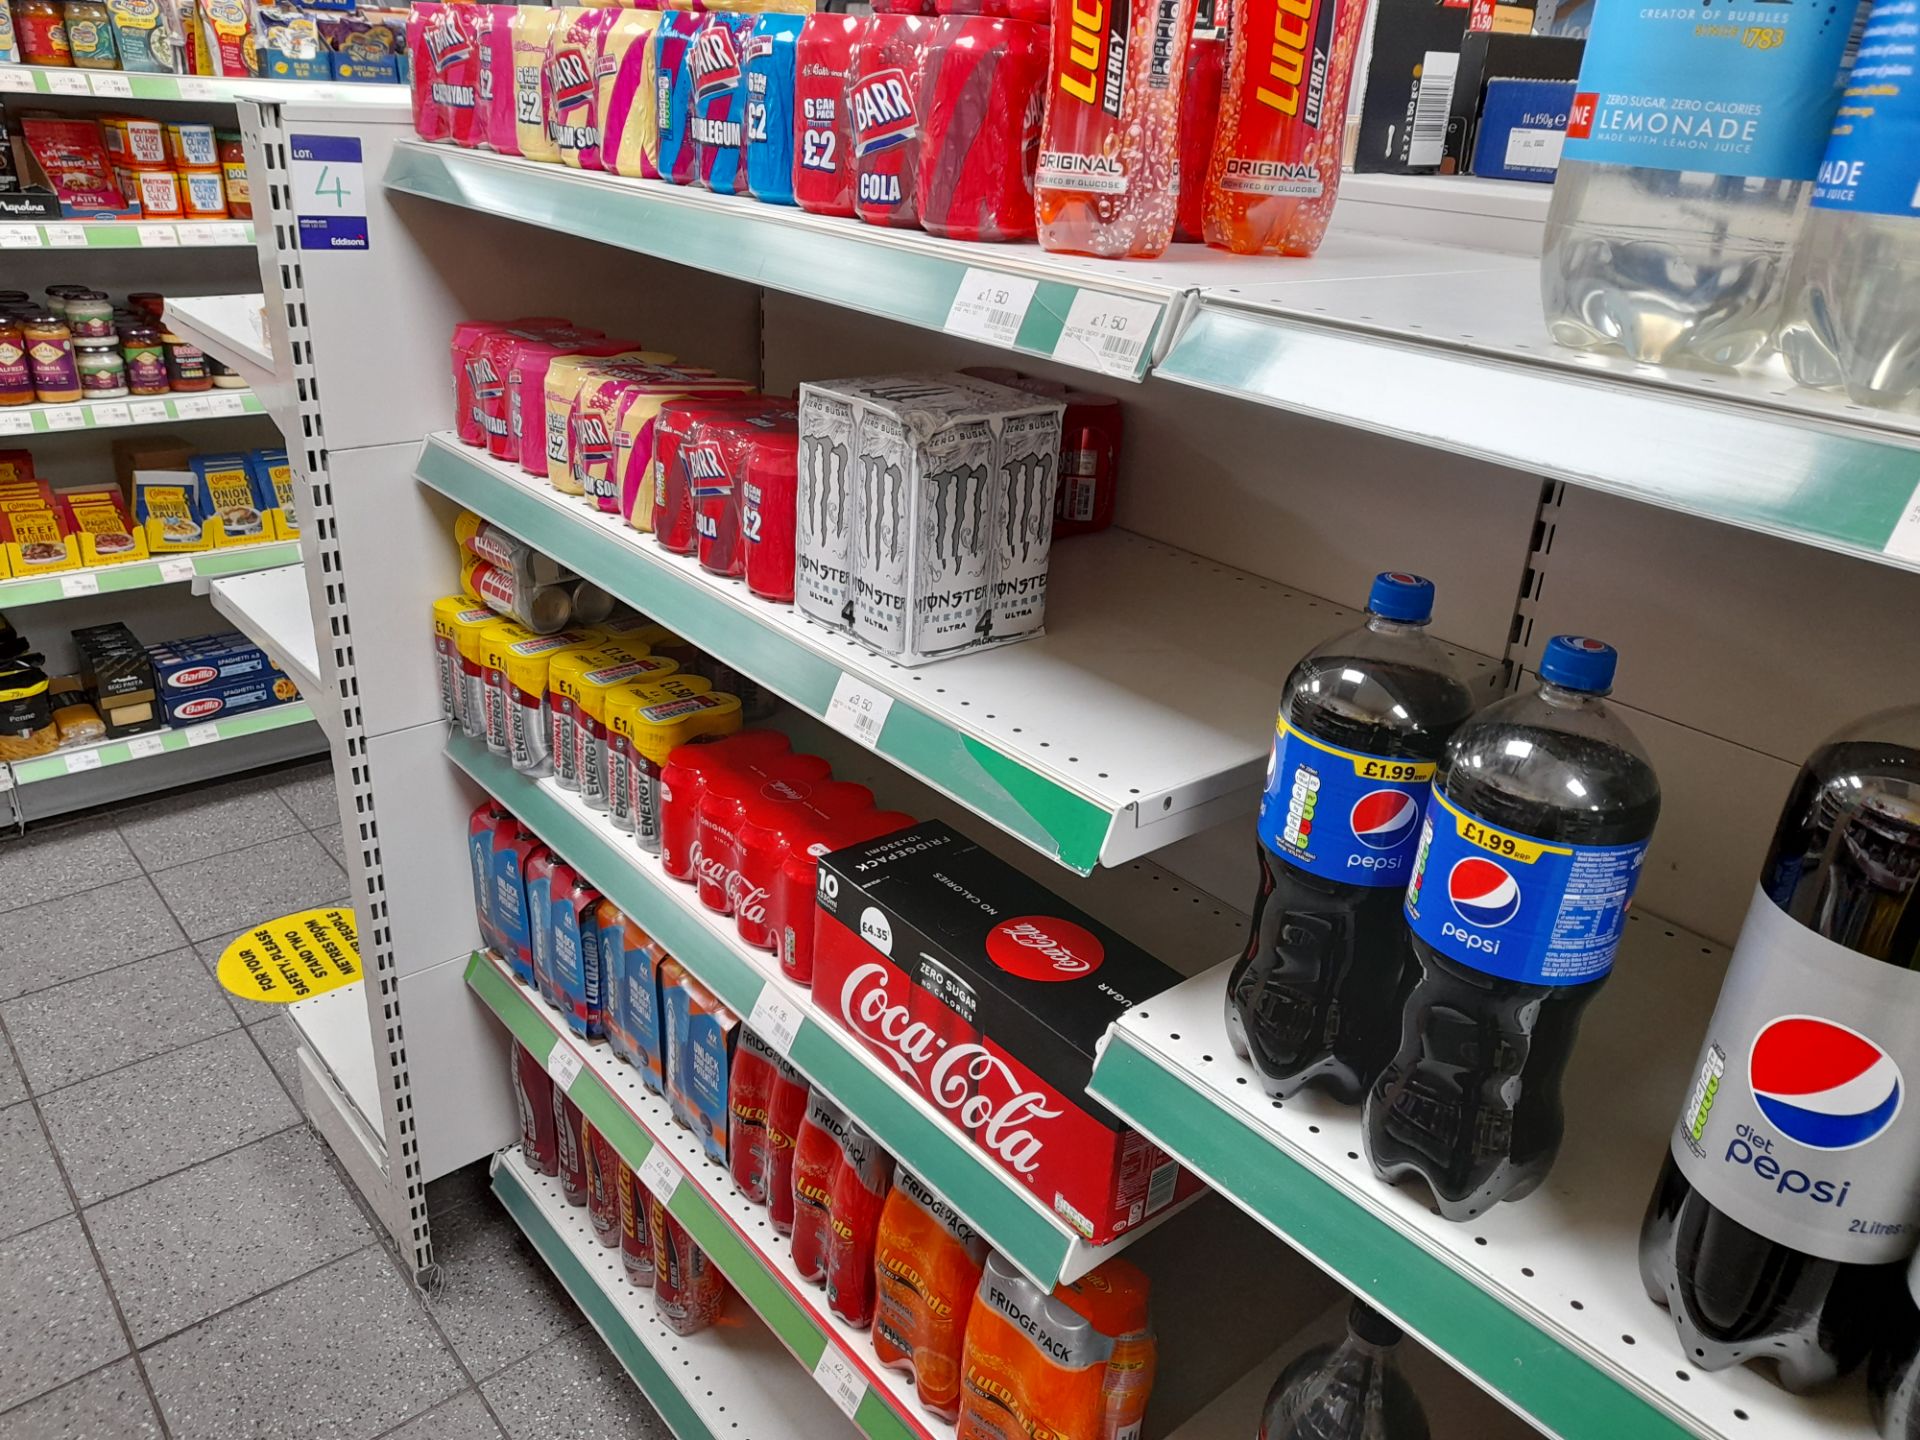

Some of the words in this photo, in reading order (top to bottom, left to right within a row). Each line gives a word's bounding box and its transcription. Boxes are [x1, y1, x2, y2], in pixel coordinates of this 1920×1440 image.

[1472, 0, 1481, 11] 2
[1481, 1, 1491, 13] for
[1639, 8, 1696, 21] CREATOR
[1702, 9, 1721, 21] OF
[1727, 10, 1790, 24] BUBBLES
[1471, 15, 1493, 30] £1.50
[1741, 26, 1785, 49] 1783
[516, 67, 524, 84] 6
[552, 54, 589, 91] BARR
[1103, 29, 1127, 113] ENERGY
[1306, 47, 1328, 124] ENERGY
[517, 91, 542, 124] £2
[804, 99, 815, 118] 6
[815, 98, 835, 111] CAN
[816, 108, 835, 121] PACK
[855, 79, 913, 132] BARR
[1605, 94, 1629, 106] ZERO
[1629, 95, 1668, 110] SUGAR,
[1671, 99, 1702, 112] ZERO
[1704, 101, 1763, 117] CALORIES
[748, 103, 767, 141] £2
[1599, 109, 1759, 142] LEMONADE
[802, 130, 837, 170] £2
[1597, 132, 1626, 144] MADE
[1628, 134, 1658, 145] WITH
[1663, 136, 1708, 151] LEMON
[1714, 142, 1752, 154] JUICE
[142, 150, 158, 161] MIX
[194, 153, 210, 162] MIX
[1040, 153, 1121, 174] ORIGINAL
[1226, 160, 1320, 180] ORIGINAL
[145, 184, 171, 194] CURRY
[193, 184, 218, 194] CURRY
[315, 165, 351, 208] 4
[860, 173, 901, 202] COLA
[1065, 177, 1075, 185] BY
[1077, 178, 1120, 189] GLUCOSE
[1263, 182, 1277, 192] BY
[1277, 183, 1319, 194] GLUCOSE
[148, 192, 171, 202] SAUCE
[153, 200, 169, 210] MIX
[194, 192, 217, 202] SAUCE
[199, 200, 215, 210] MIX
[1826, 189, 1856, 202] JUICE
[330, 236, 365, 246] Eddisons
[977, 287, 1010, 306] £1.50
[1090, 312, 1129, 332] £1.50
[929, 435, 957, 448] ZERO
[959, 429, 988, 442] SUGAR
[1005, 422, 1026, 434] ZERO
[1029, 419, 1055, 431] SUGAR
[548, 433, 568, 464] £2
[689, 447, 725, 480] BARR
[212, 488, 249, 500] ONION
[215, 497, 252, 508] SAUCE
[152, 510, 189, 519] SAUCE
[743, 504, 761, 542] £2
[15, 526, 54, 535] BEEF
[809, 590, 834, 606] ULTRA
[914, 583, 989, 615] MONSTER
[841, 599, 856, 628] 4
[864, 615, 889, 632] ULTRA
[974, 608, 994, 637] 4
[1004, 608, 1033, 620] ULTRA
[936, 622, 967, 634] ULTRA
[217, 654, 250, 666] SPAGHETTI
[107, 682, 121, 691] EGG
[122, 678, 144, 689] PASTA
[178, 667, 219, 685] Barilla
[441, 657, 452, 714] ENERGY
[222, 685, 253, 697] SPAGHETTI
[660, 680, 695, 699] £1.50
[9, 711, 36, 723] Penne
[184, 699, 224, 715] Barilla
[492, 689, 504, 747] ENERGY
[512, 705, 529, 763] ENERGY
[562, 716, 574, 780] ENERGY
[584, 733, 600, 796] ENERGY
[1362, 761, 1416, 781] £1.99
[615, 754, 629, 819] ENERGY
[638, 773, 654, 837] ENERGY
[700, 815, 735, 842] ORIGINAL
[1462, 822, 1517, 856] £1.99
[1514, 851, 1531, 861] RRP
[1346, 854, 1404, 872] pepsi
[689, 839, 771, 925] Coca-Cola
[818, 867, 839, 900] 10
[932, 871, 981, 905] CALORIES
[817, 889, 838, 909] x330ml
[980, 903, 998, 917] NO
[303, 918, 332, 944] FROM
[326, 911, 358, 943] PEOPLE
[862, 921, 890, 943] £4.35
[1441, 921, 1500, 956] pepsi
[254, 929, 287, 962] PLEASE
[283, 930, 307, 952] TWO
[1000, 922, 1091, 973] Coca-Cola
[238, 948, 264, 976] YOUR
[298, 949, 329, 979] STAND
[321, 941, 357, 976] METRES
[584, 934, 600, 1006] LUCOZADE
[255, 971, 278, 992] FOR
[276, 958, 311, 996] SAFETY,
[919, 962, 944, 985] ZERO
[945, 979, 977, 1013] SUGAR
[921, 979, 931, 991] NO
[933, 987, 974, 1023] CALORIES
[1097, 982, 1133, 1010] UGAR
[693, 1040, 720, 1070] UNLOCK
[840, 961, 1064, 1176] Coca-Cola
[1735, 1123, 1776, 1156] diet
[1724, 1138, 1852, 1208] pepsi
[901, 1173, 946, 1218] FRIDGE
[943, 1205, 977, 1245] PACK
[879, 1247, 953, 1319] Lucozade
[989, 1287, 1037, 1336] FRIDGE
[1037, 1329, 1073, 1363] PACK
[967, 1364, 1052, 1440] Lucozade
